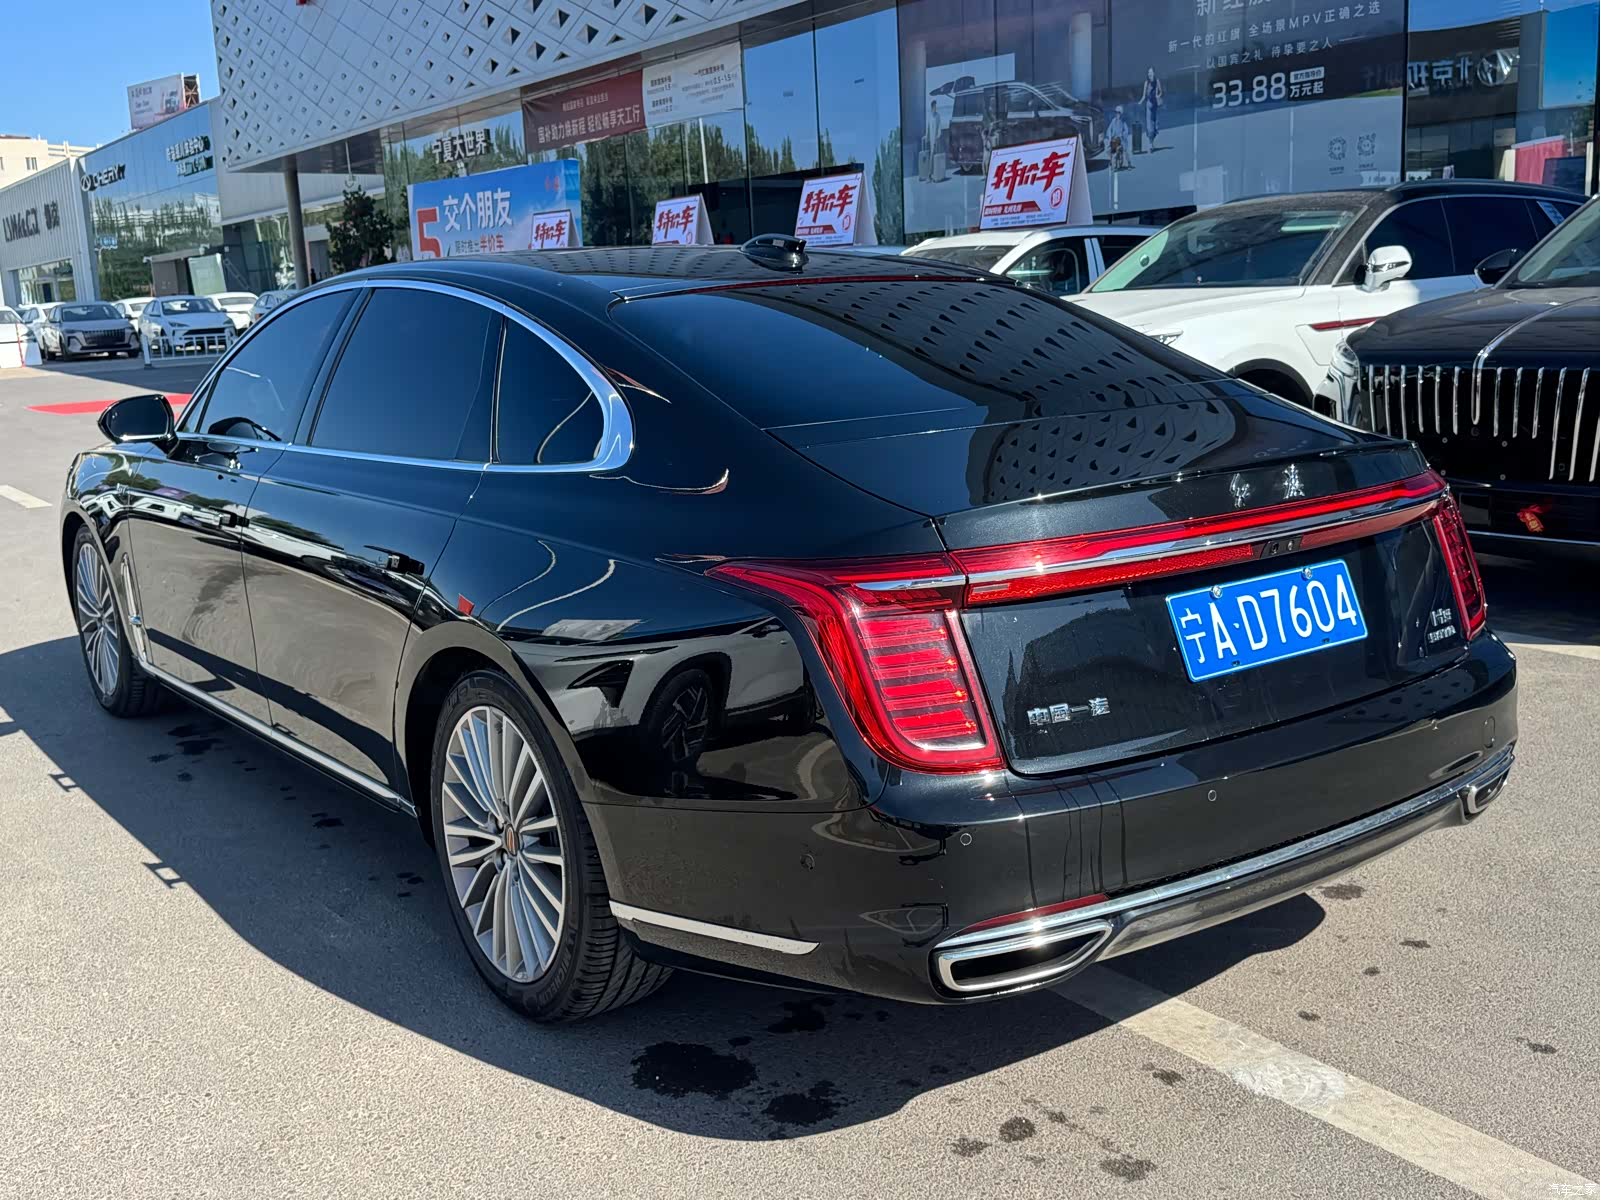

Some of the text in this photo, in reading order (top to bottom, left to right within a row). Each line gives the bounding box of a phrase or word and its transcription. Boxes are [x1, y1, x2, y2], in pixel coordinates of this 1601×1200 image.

[1168, 1, 1381, 53] 新一代的红旗 全场景MPV正确之选
[1206, 49, 1263, 69] 以国宾之礼
[1212, 72, 1286, 109] 33.88
[1290, 81, 1324, 98] 万元起
[588, 104, 641, 133] 轻松畅享天工行
[432, 129, 487, 164] 宁夏大世界
[990, 152, 1071, 201] 特价车
[443, 187, 513, 233] 交个朋友
[802, 184, 858, 224] 特价车
[534, 219, 567, 248] 特价车
[656, 205, 697, 240] 特价车
[1179, 573, 1358, 665] 宁A·D7604
[1027, 697, 1111, 726] 中国一汽
